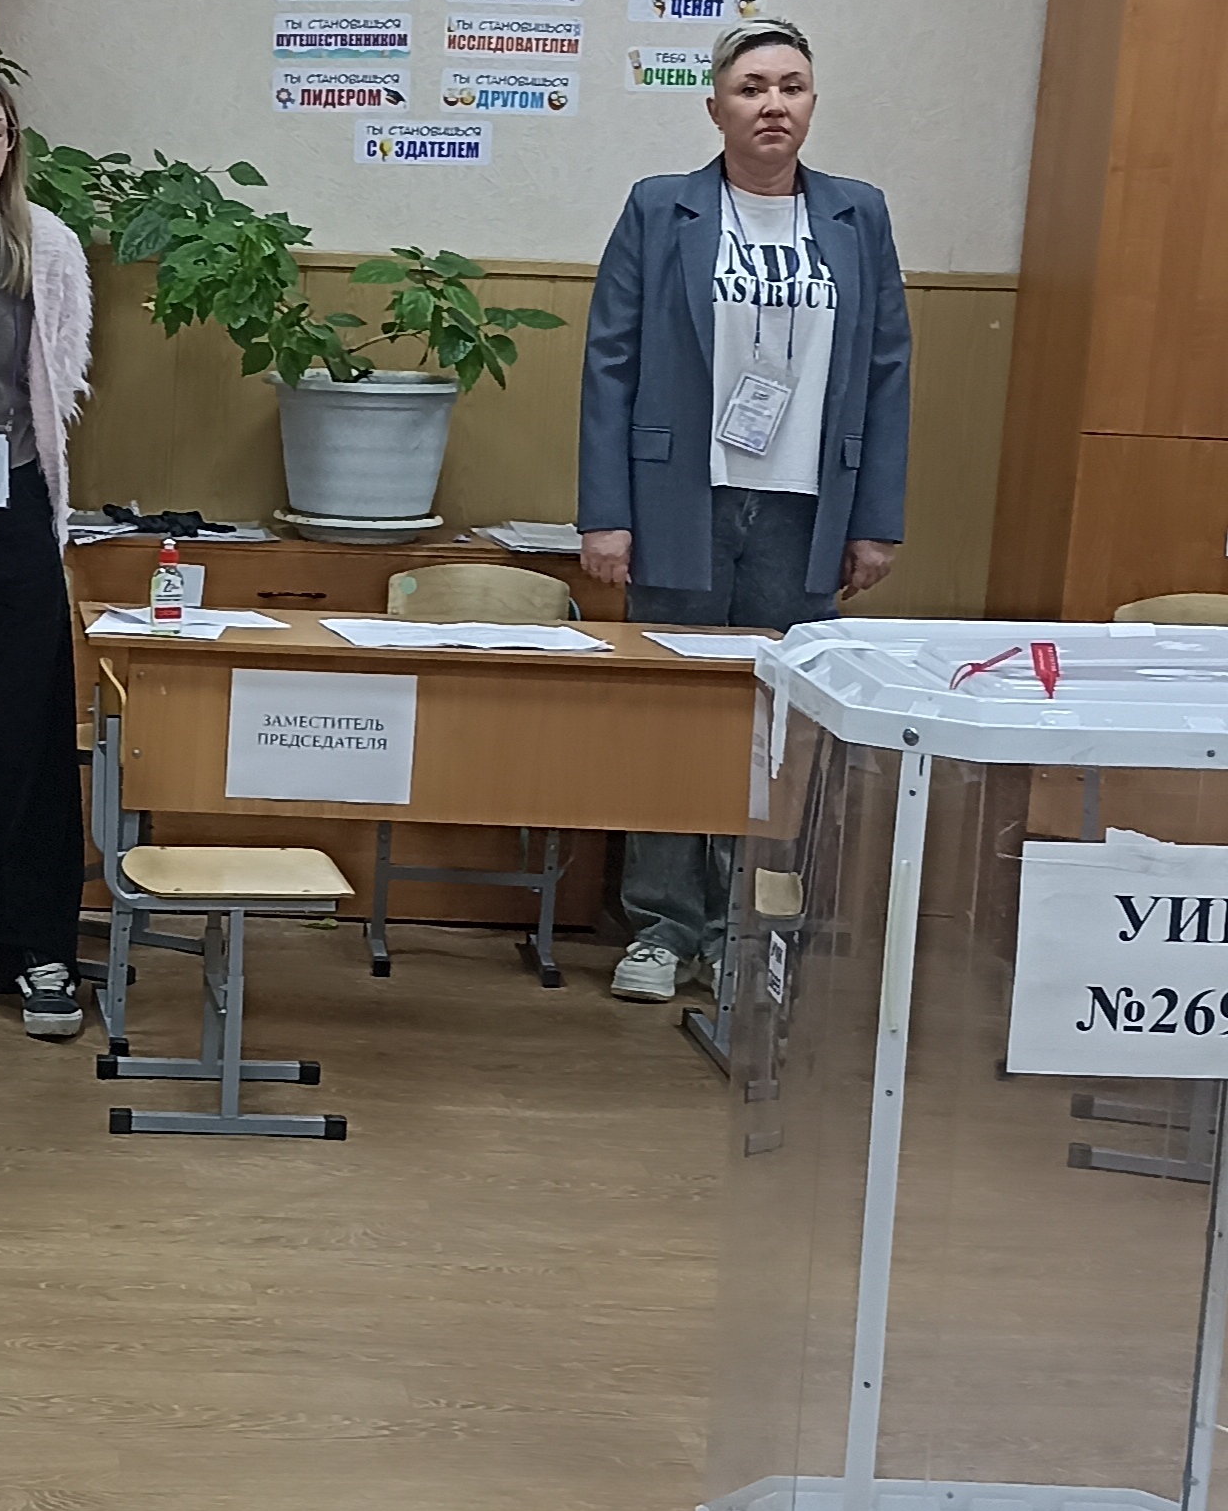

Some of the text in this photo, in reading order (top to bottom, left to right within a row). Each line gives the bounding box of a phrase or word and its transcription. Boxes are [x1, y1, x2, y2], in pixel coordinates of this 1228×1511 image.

[285, 18, 402, 30] ТЫ СТАНОВИШЬСЯ
[456, 20, 572, 33] ТЫ СТАНОВИШЬСЯ
[275, 33, 408, 47] ПУТЕШЕСТВЕННИКОМ
[447, 34, 579, 54] ИССЛЕДОВАТЕЛЕМ
[655, 52, 686, 63] ТЕБЯ
[283, 73, 400, 84] ТЫ СТАНОВИШЬСЯ
[453, 74, 569, 87] ТЫ СТАНОВИШЬСЯ
[643, 67, 697, 85] ОЧЕНЬ
[299, 88, 382, 109] ЛИДЕРОМ
[476, 89, 544, 110] ДРУГОМ
[366, 125, 482, 137] ТЫ СТАНОВИШЬСЯ
[366, 140, 480, 161] СЗДАТЕЛЕМ
[263, 714, 384, 731] ЗАМЕСТИТЕЛЬ
[257, 733, 388, 750] ПРЕДСЕДАТЕЛЯ
[1114, 894, 1228, 944] УИ
[1076, 986, 1228, 1036] №26
